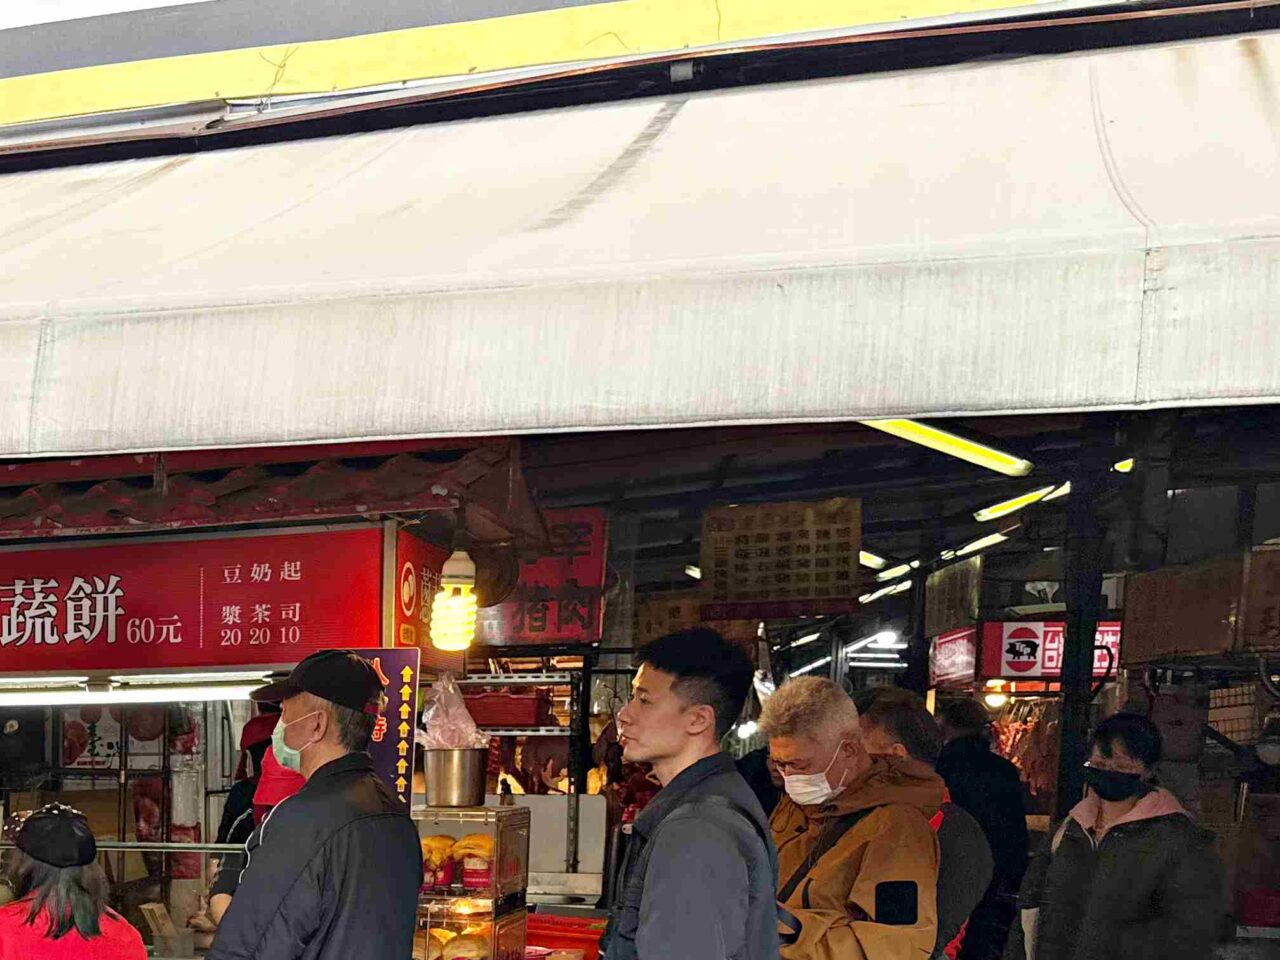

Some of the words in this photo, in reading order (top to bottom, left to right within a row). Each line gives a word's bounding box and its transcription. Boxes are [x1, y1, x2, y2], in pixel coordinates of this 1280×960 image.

[126, 614, 183, 645] 60元
[221, 629, 242, 645] 20
[249, 628, 270, 645] 20
[279, 626, 300, 644] 10
